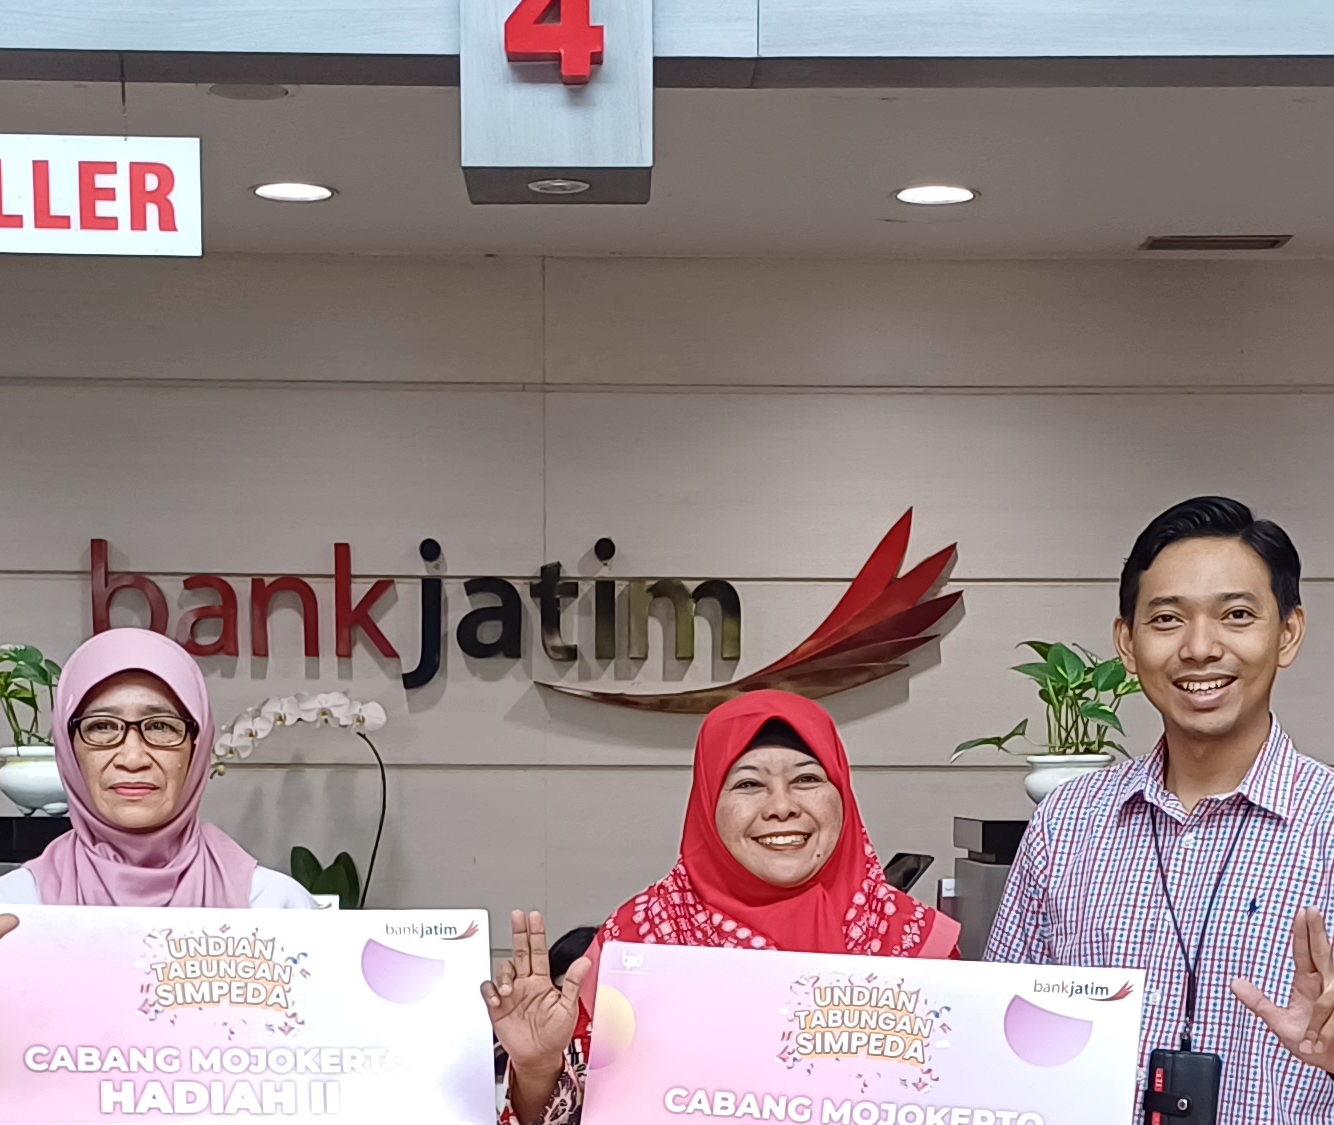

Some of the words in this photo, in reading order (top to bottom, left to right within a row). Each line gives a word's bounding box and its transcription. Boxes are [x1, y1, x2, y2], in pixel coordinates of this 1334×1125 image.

[504, 0, 604, 85] 4
[90, 538, 742, 689] bankjatim
[385, 923, 458, 938] bankjatim
[168, 936, 275, 961] UNDIAN
[151, 959, 292, 984] TABUNGAN
[155, 980, 288, 1009] SIMPEDA
[813, 985, 920, 1014] UNDIAN
[1033, 979, 1109, 998] bankjatim
[794, 1009, 933, 1038] TABUNGAN
[23, 1045, 180, 1073] CABANG
[796, 1031, 925, 1064] SIMPEDA
[100, 1079, 297, 1115] HADIAH
[309, 1080, 341, 1115] II
[663, 1087, 812, 1123] CABANG
